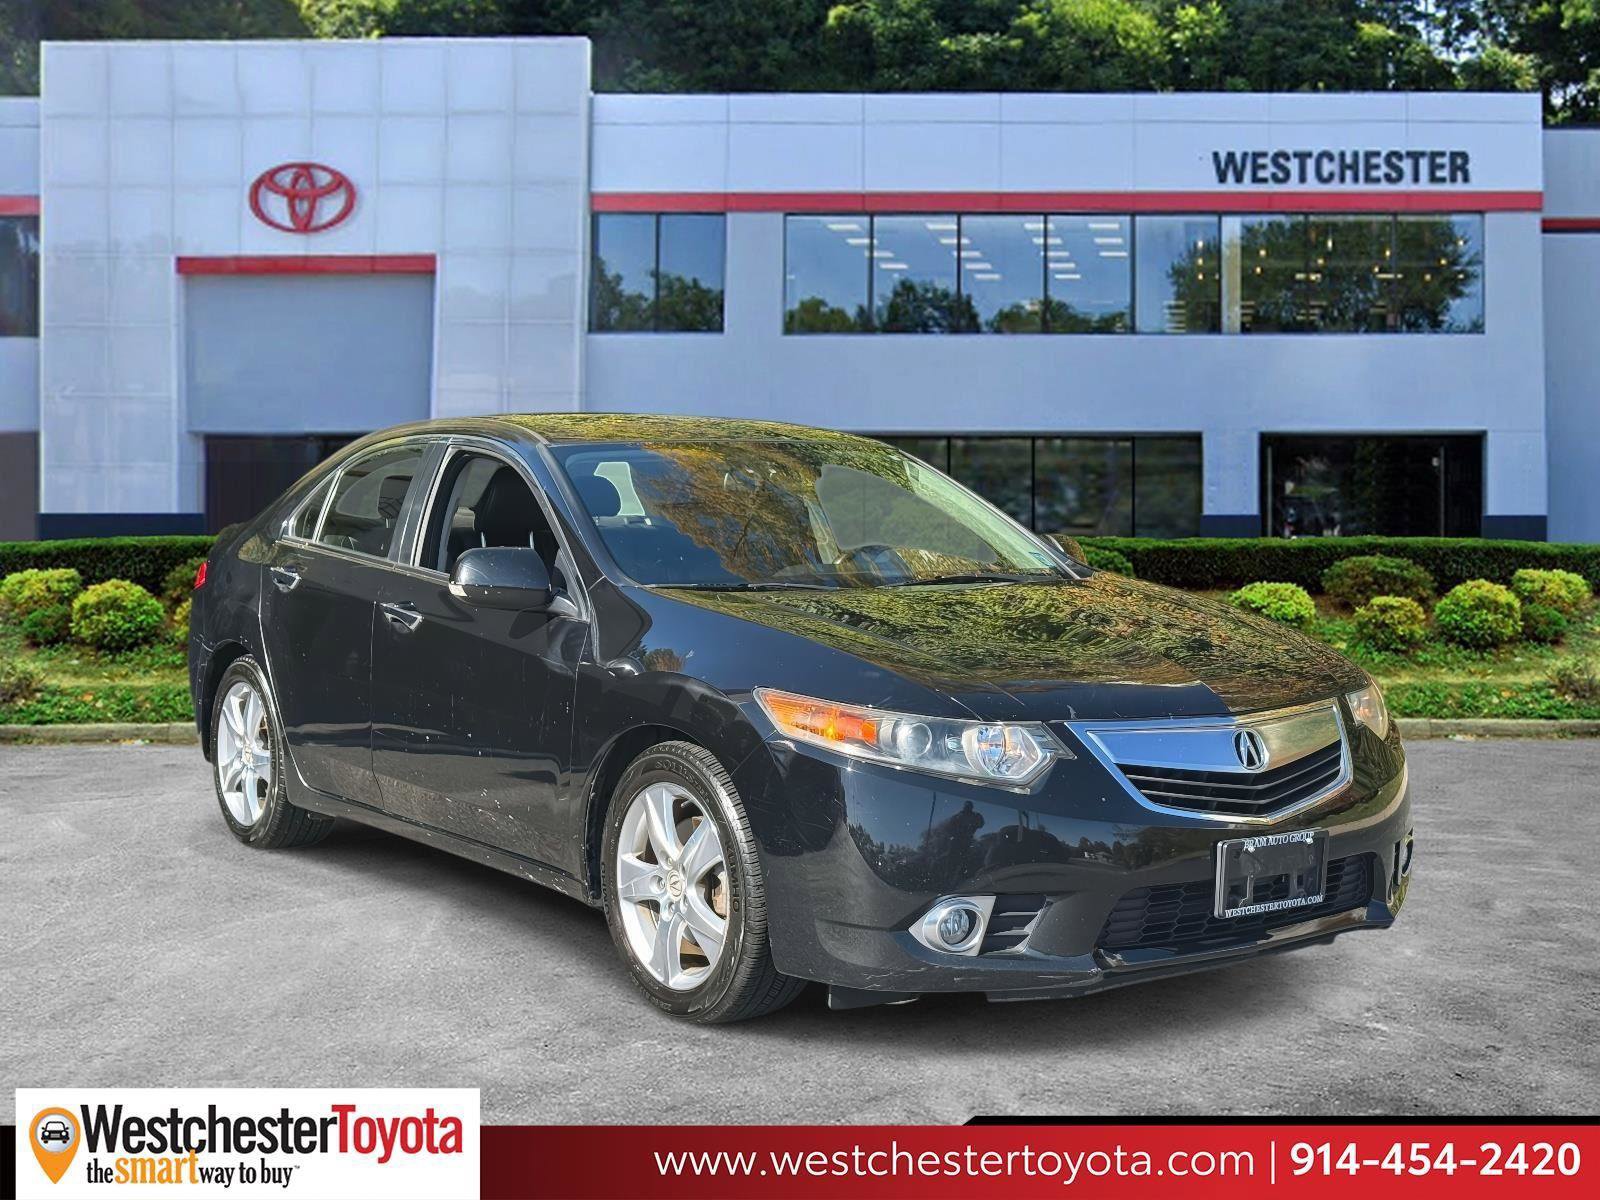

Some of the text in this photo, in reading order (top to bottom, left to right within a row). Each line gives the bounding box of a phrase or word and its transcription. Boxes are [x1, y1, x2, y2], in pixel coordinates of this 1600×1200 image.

[1212, 150, 1471, 185] WESTCHESTER
[1267, 834, 1288, 846] AUTO
[1289, 831, 1315, 843] GROUP
[1224, 893, 1324, 918] WESTCHESTERTOYOTA.COM
